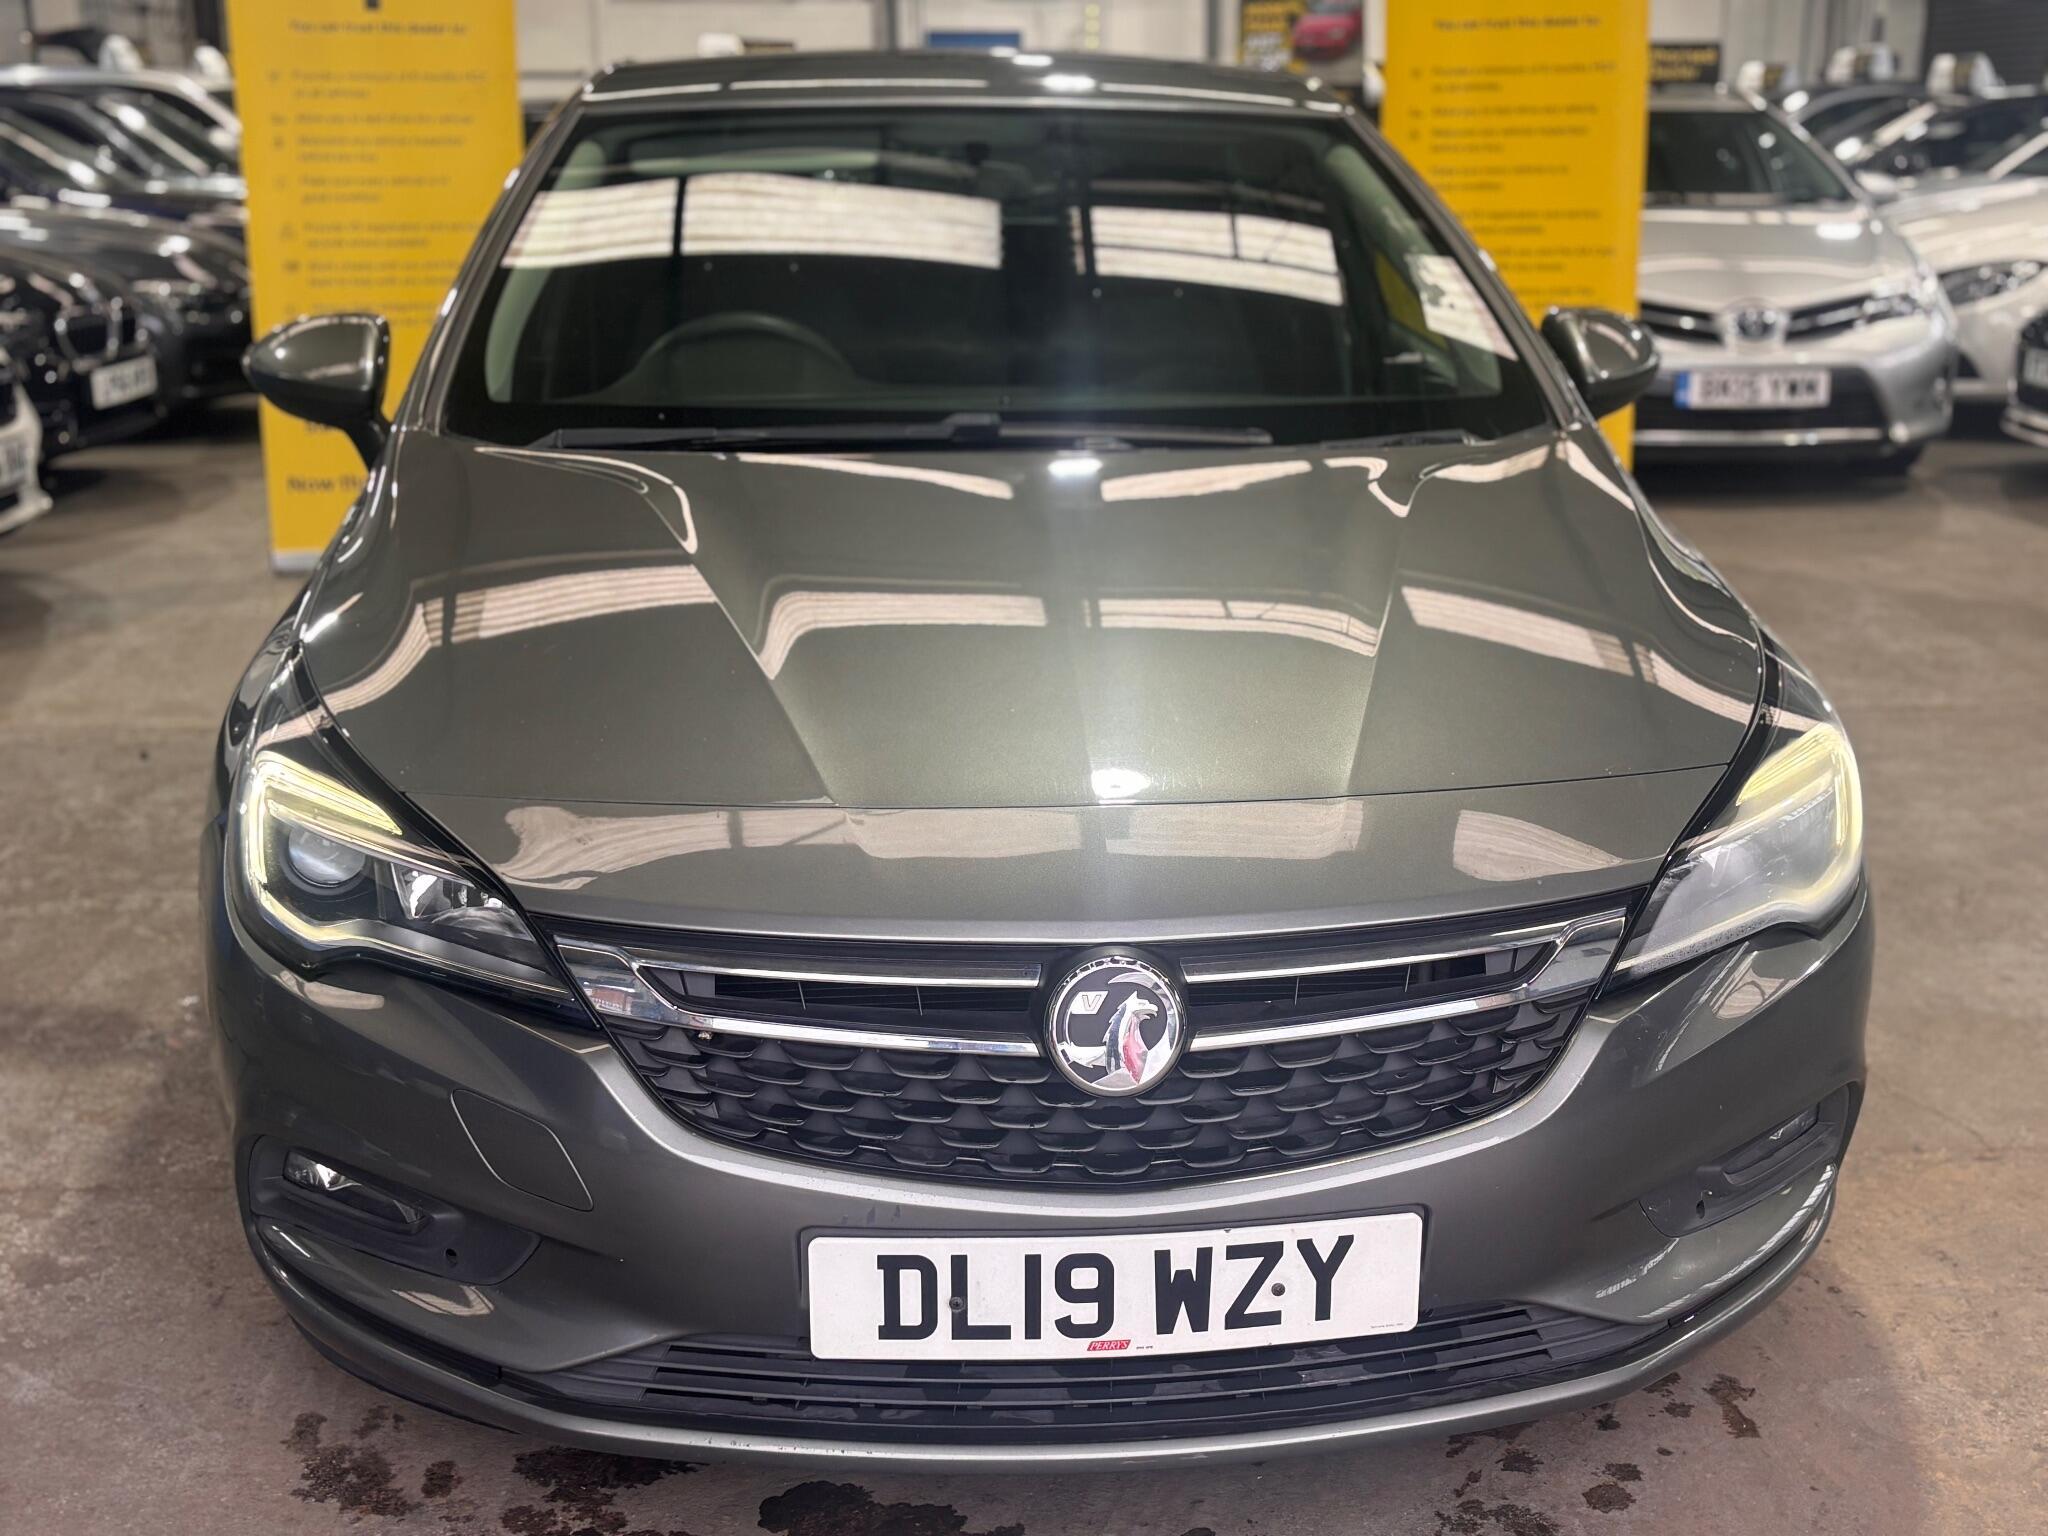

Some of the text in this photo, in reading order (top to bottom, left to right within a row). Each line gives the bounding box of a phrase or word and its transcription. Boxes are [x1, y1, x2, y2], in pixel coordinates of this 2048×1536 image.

[877, 1234, 1355, 1340] DL19 WZY
[1089, 1340, 1130, 1351] PERRYS
